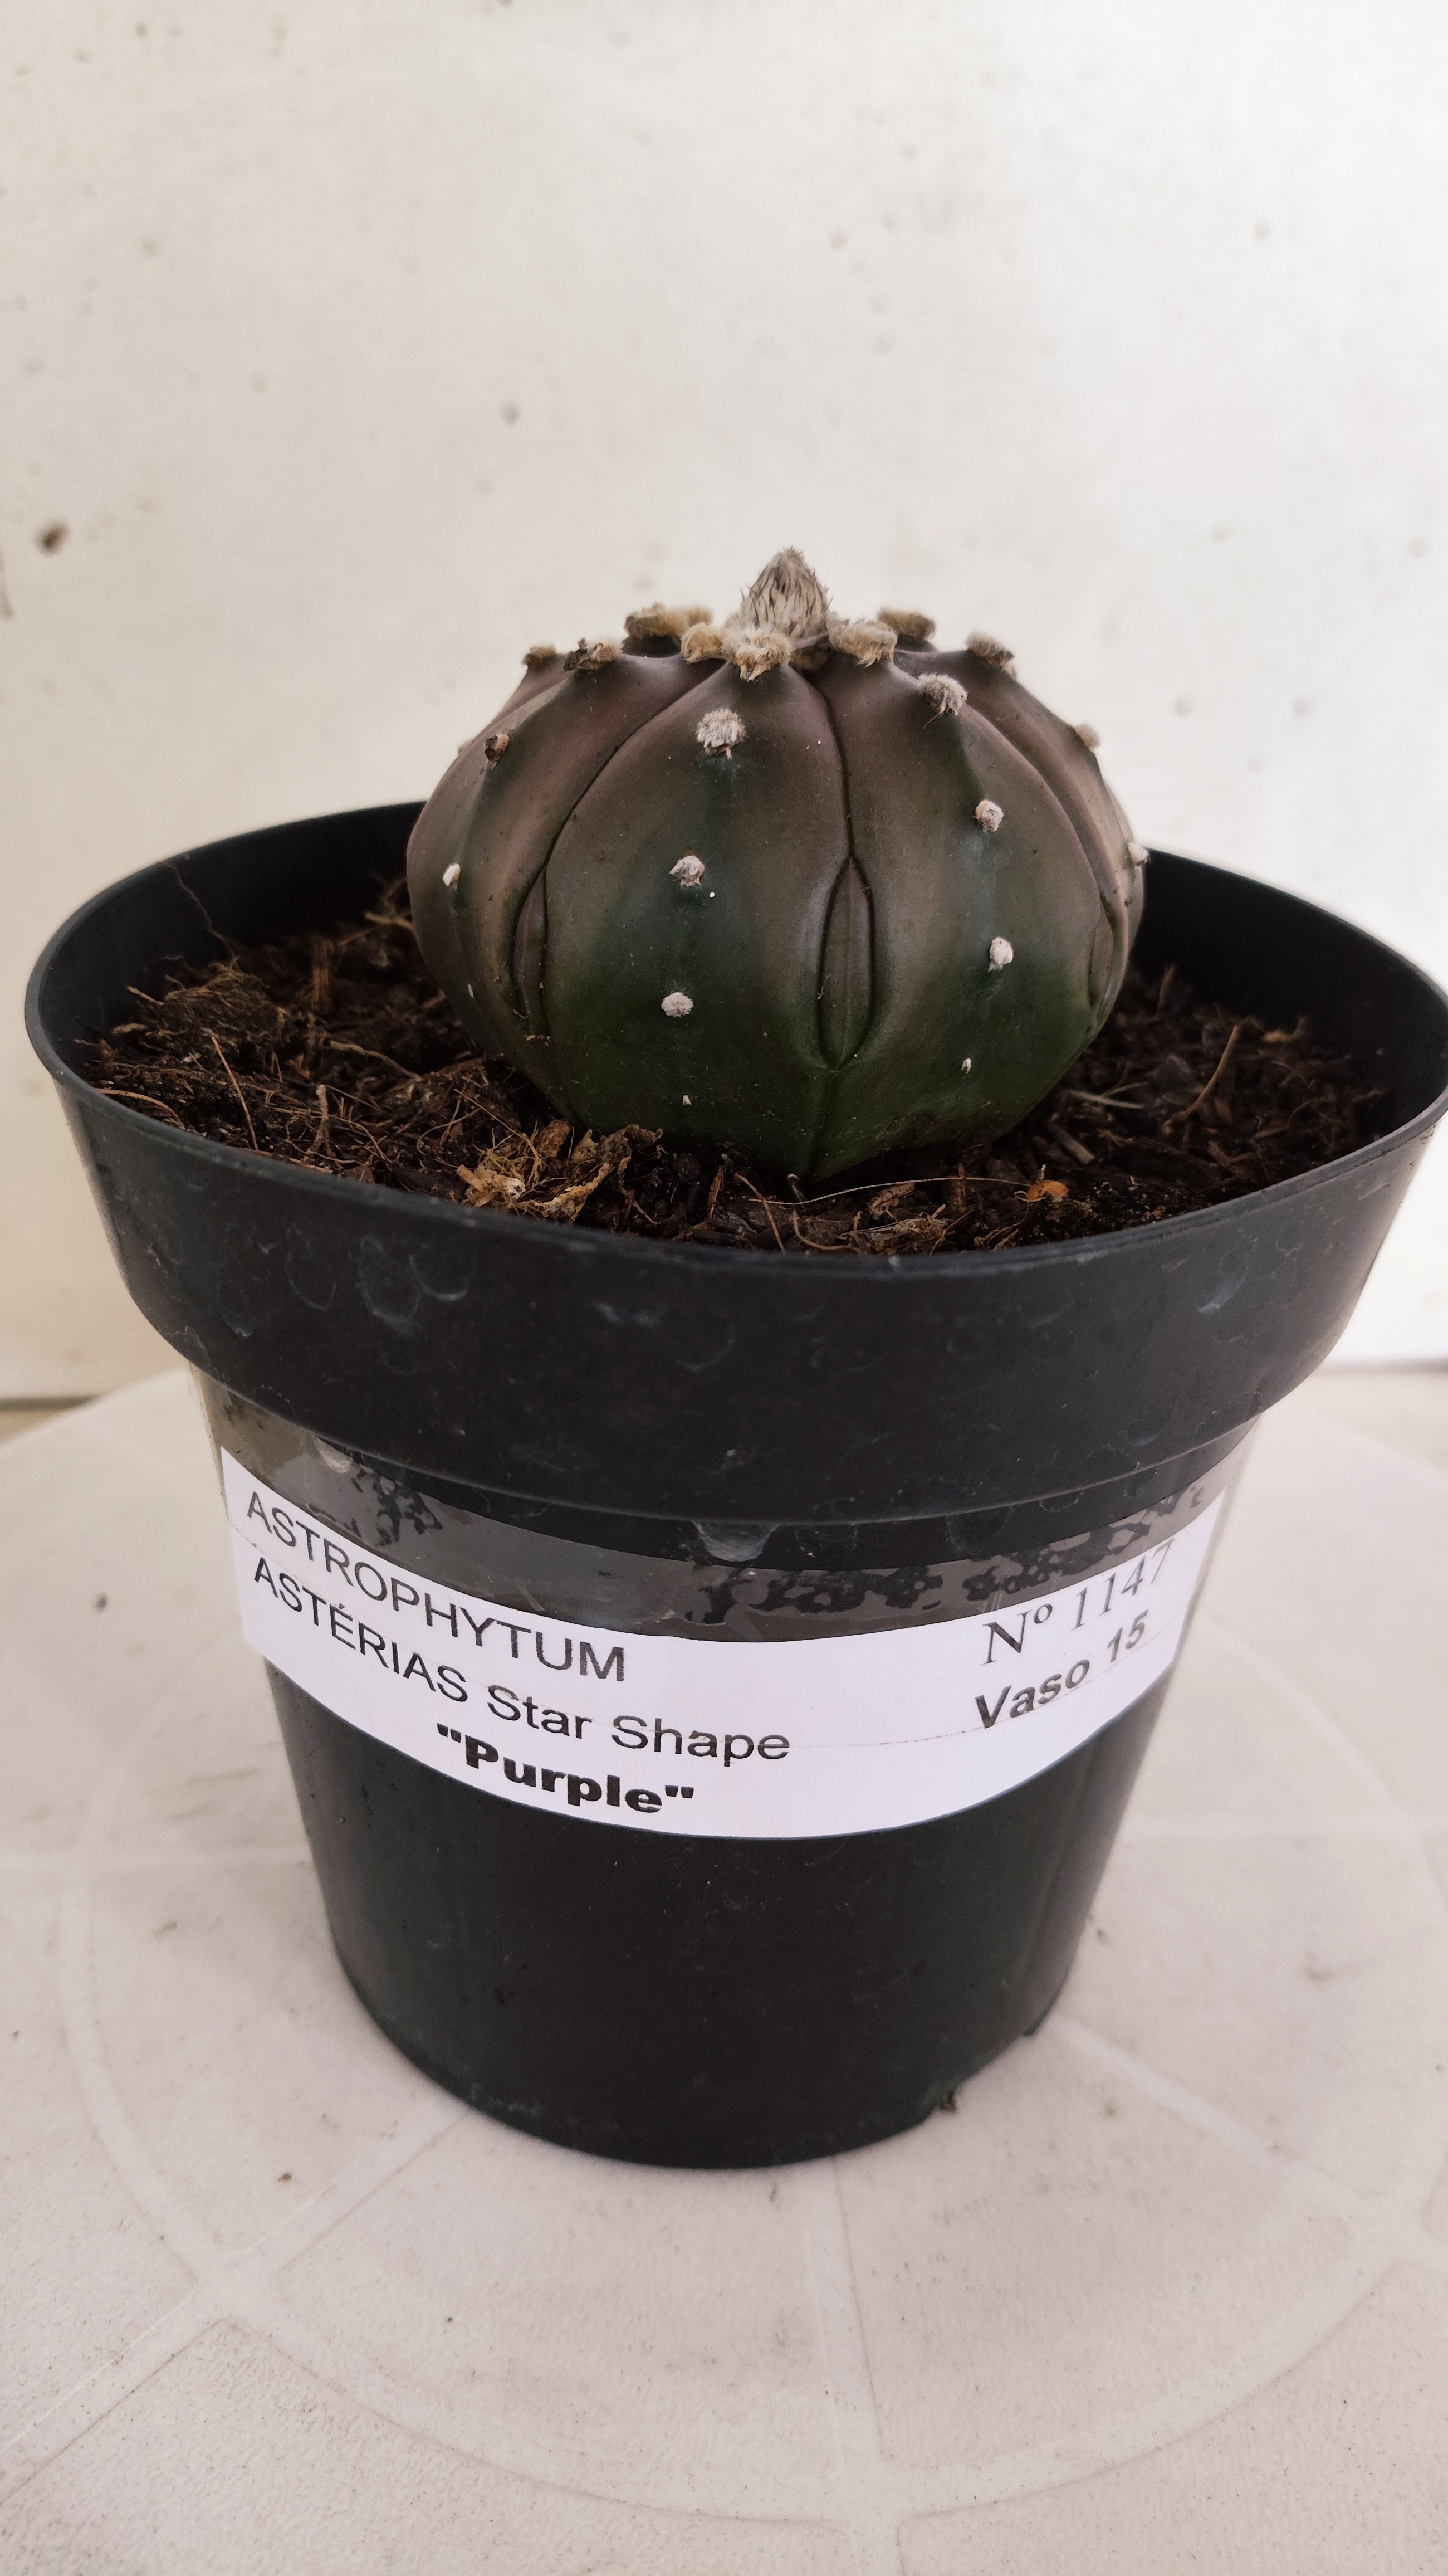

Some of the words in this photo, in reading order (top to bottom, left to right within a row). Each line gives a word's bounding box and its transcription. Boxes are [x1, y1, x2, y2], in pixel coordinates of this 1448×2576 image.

[247, 1491, 624, 1682] ASTROPHYTUM
[1070, 1538, 1175, 1631] 1147
[253, 1557, 469, 1702] ASTÉRIAS
[487, 1684, 593, 1740] Star
[611, 1715, 791, 1767] Shape
[975, 1659, 1090, 1729] Vaso
[1106, 1608, 1149, 1663] 15
[437, 1723, 694, 1813] "Purple"
